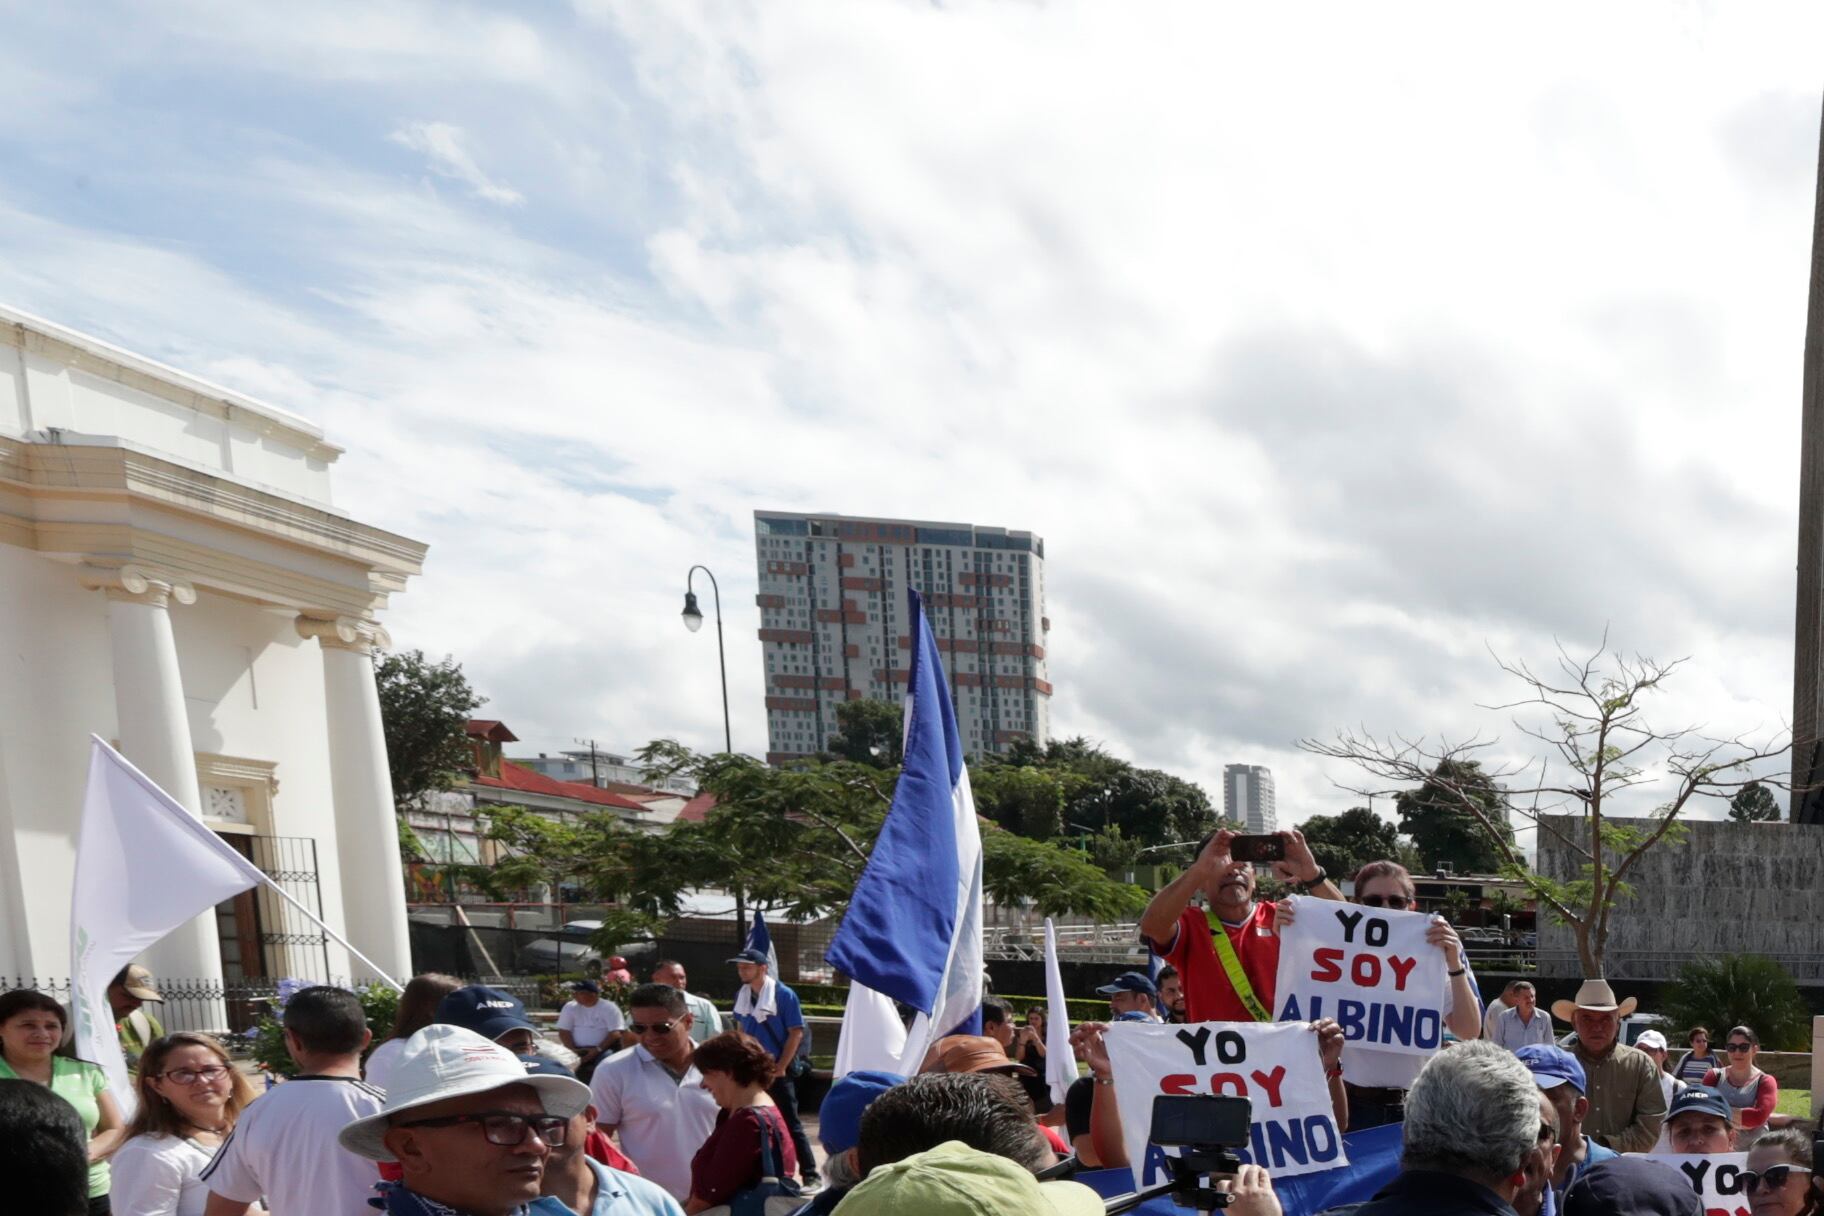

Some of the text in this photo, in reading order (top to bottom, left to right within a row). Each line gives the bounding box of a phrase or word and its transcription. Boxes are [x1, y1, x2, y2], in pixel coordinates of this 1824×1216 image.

[1335, 909, 1389, 947] YO
[1311, 947, 1417, 991] SOY
[1176, 1026, 1247, 1065] YO
[1142, 1114, 1338, 1186] AINO
[1680, 1159, 1742, 1196] YO
